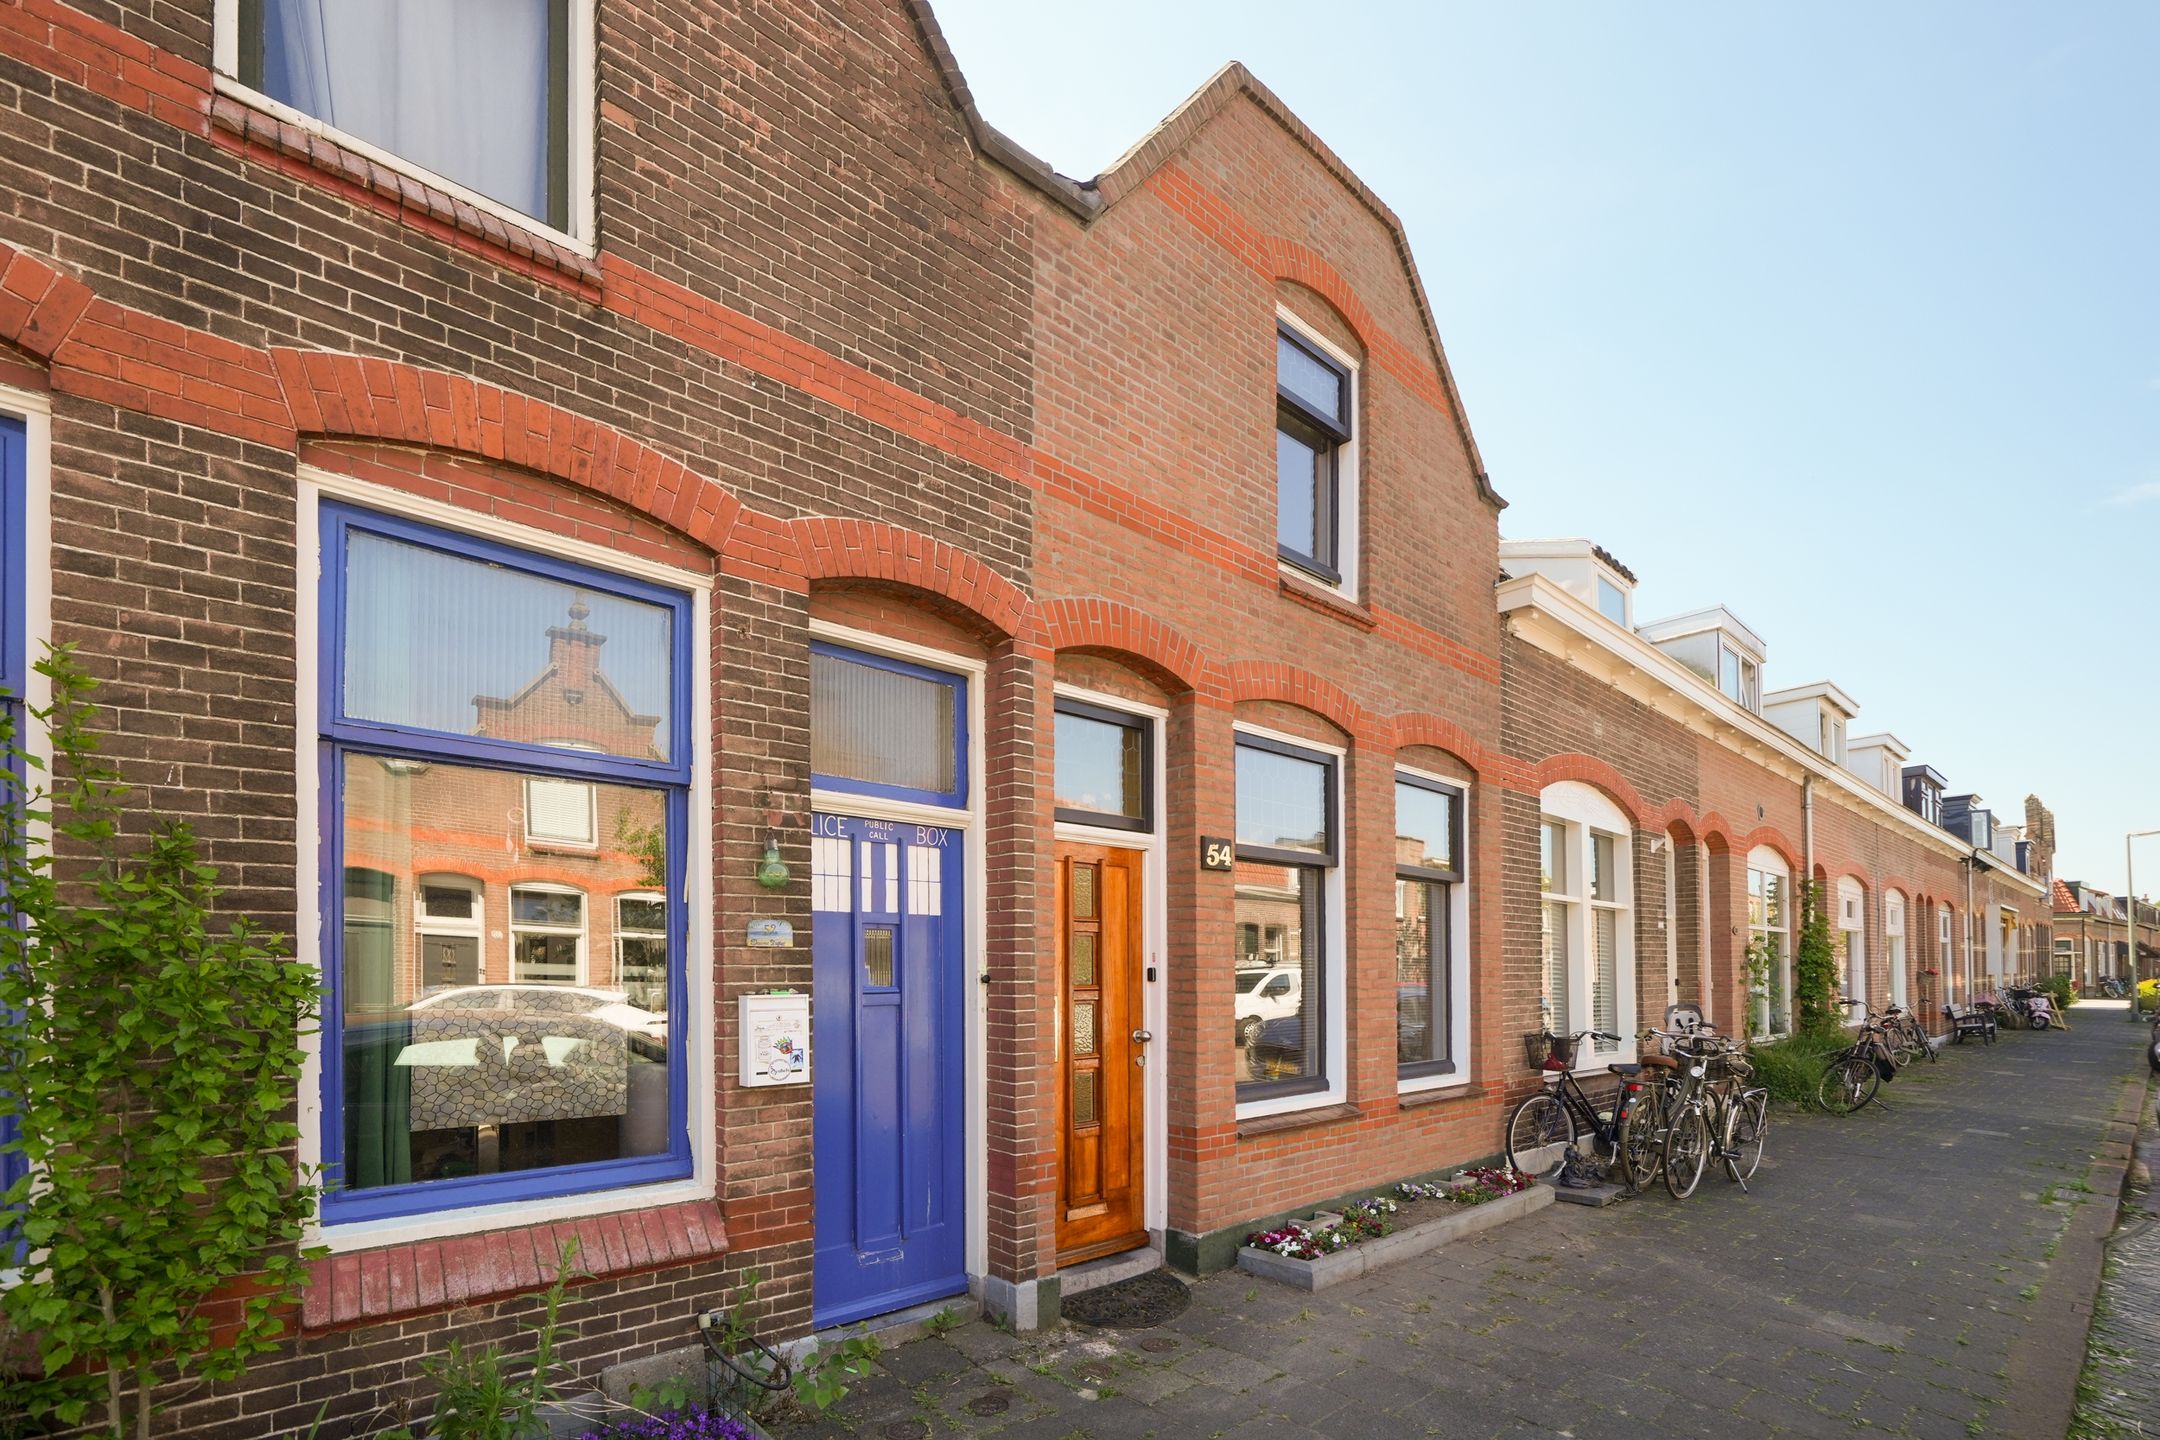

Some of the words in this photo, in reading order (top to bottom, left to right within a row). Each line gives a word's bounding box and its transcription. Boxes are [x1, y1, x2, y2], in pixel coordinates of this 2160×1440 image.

[864, 820, 894, 831] PUBLIC
[869, 831, 888, 841] CALL
[916, 825, 948, 847] BOX
[1206, 844, 1232, 866] 54
